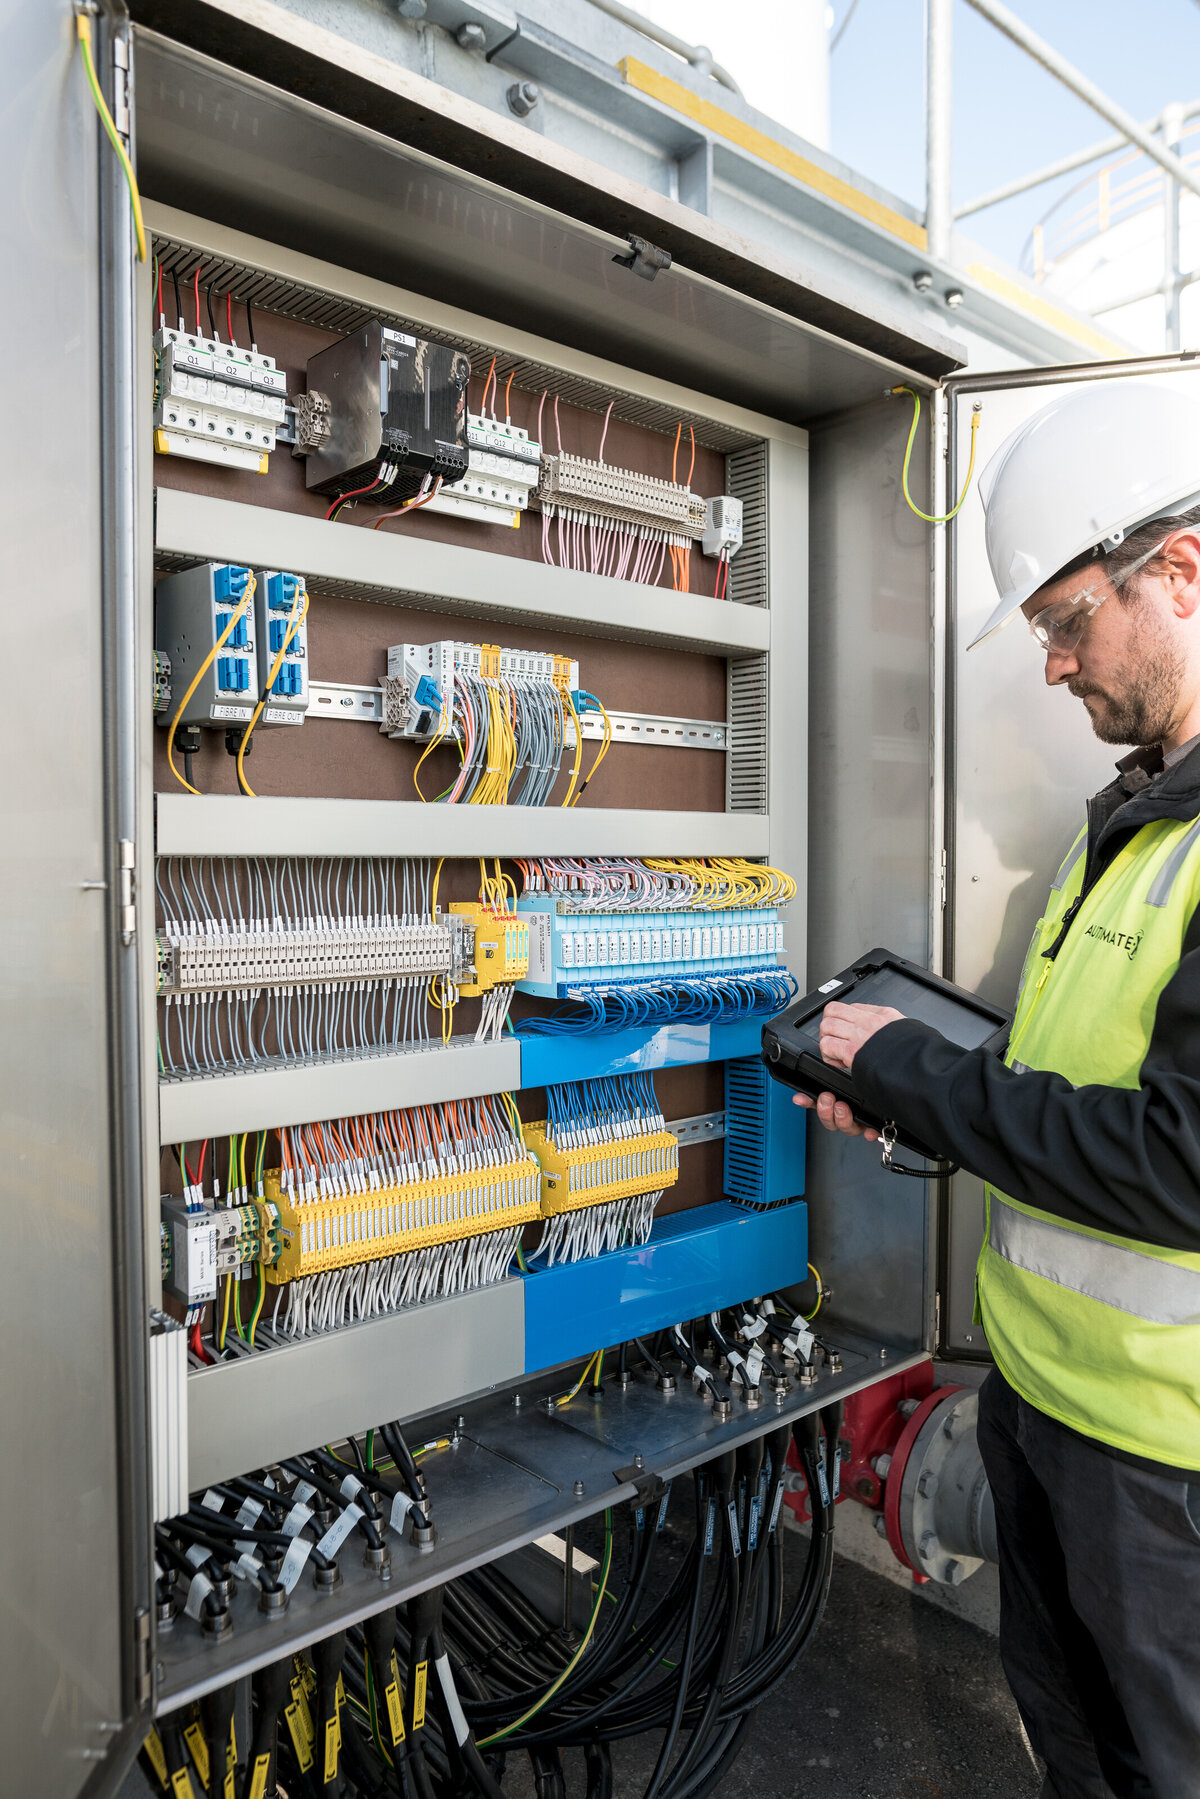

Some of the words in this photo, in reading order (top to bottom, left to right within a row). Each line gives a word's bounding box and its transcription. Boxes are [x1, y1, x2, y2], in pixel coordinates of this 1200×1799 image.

[393, 332, 406, 343] PS1
[187, 355, 199, 365] Q1
[226, 366, 237, 375] Q2
[263, 376, 274, 385] Q3
[494, 438, 506, 447] Q12
[521, 446, 533, 455] Q13
[220, 706, 238, 717] FIBRE
[239, 708, 246, 717] IN
[269, 710, 286, 720] FIBRE
[287, 712, 301, 721] OUT
